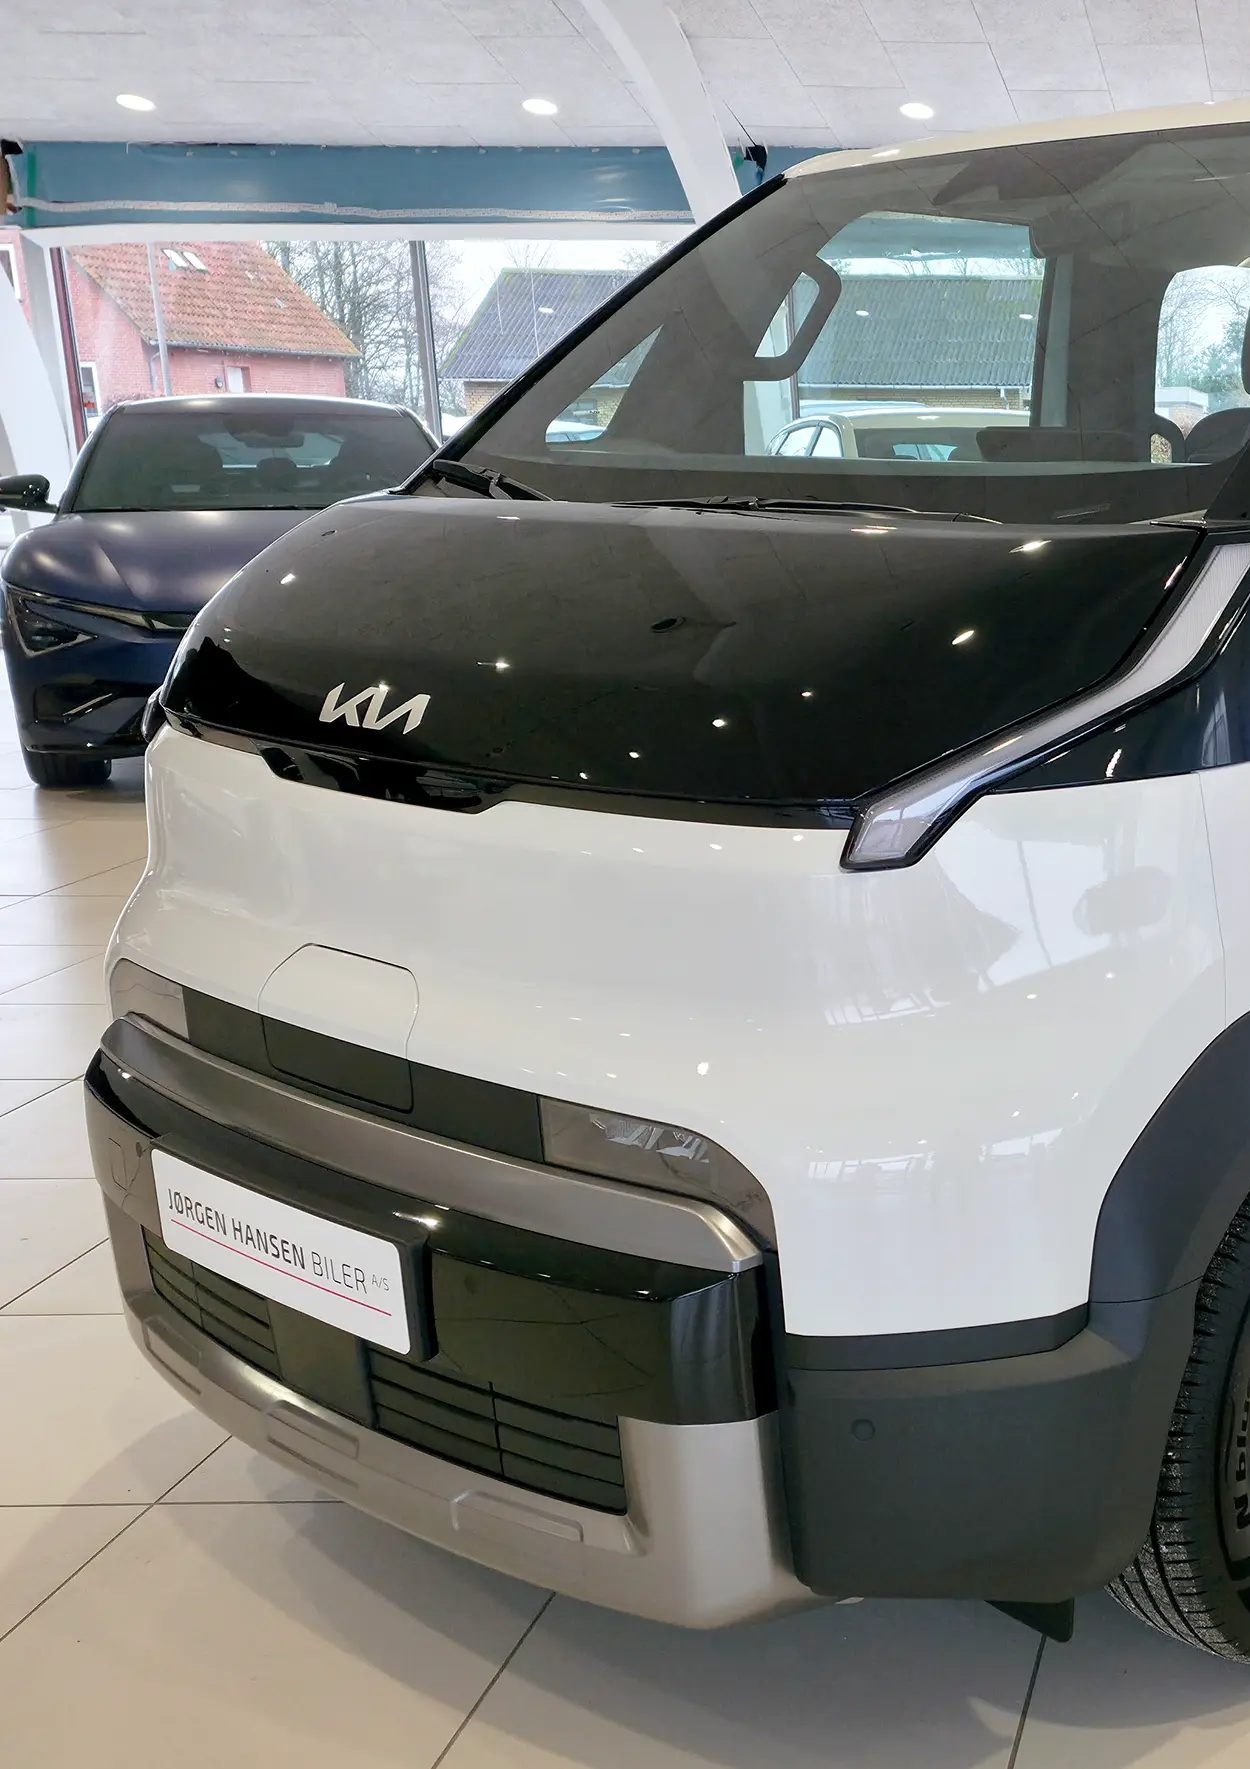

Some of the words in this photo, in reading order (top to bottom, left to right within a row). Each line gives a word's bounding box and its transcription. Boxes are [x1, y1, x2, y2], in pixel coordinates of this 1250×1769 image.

[168, 1188, 227, 1236] JØRGEN
[231, 1217, 306, 1270] HANSEN
[311, 1250, 368, 1294] BILER
[371, 1273, 391, 1292] A/S
